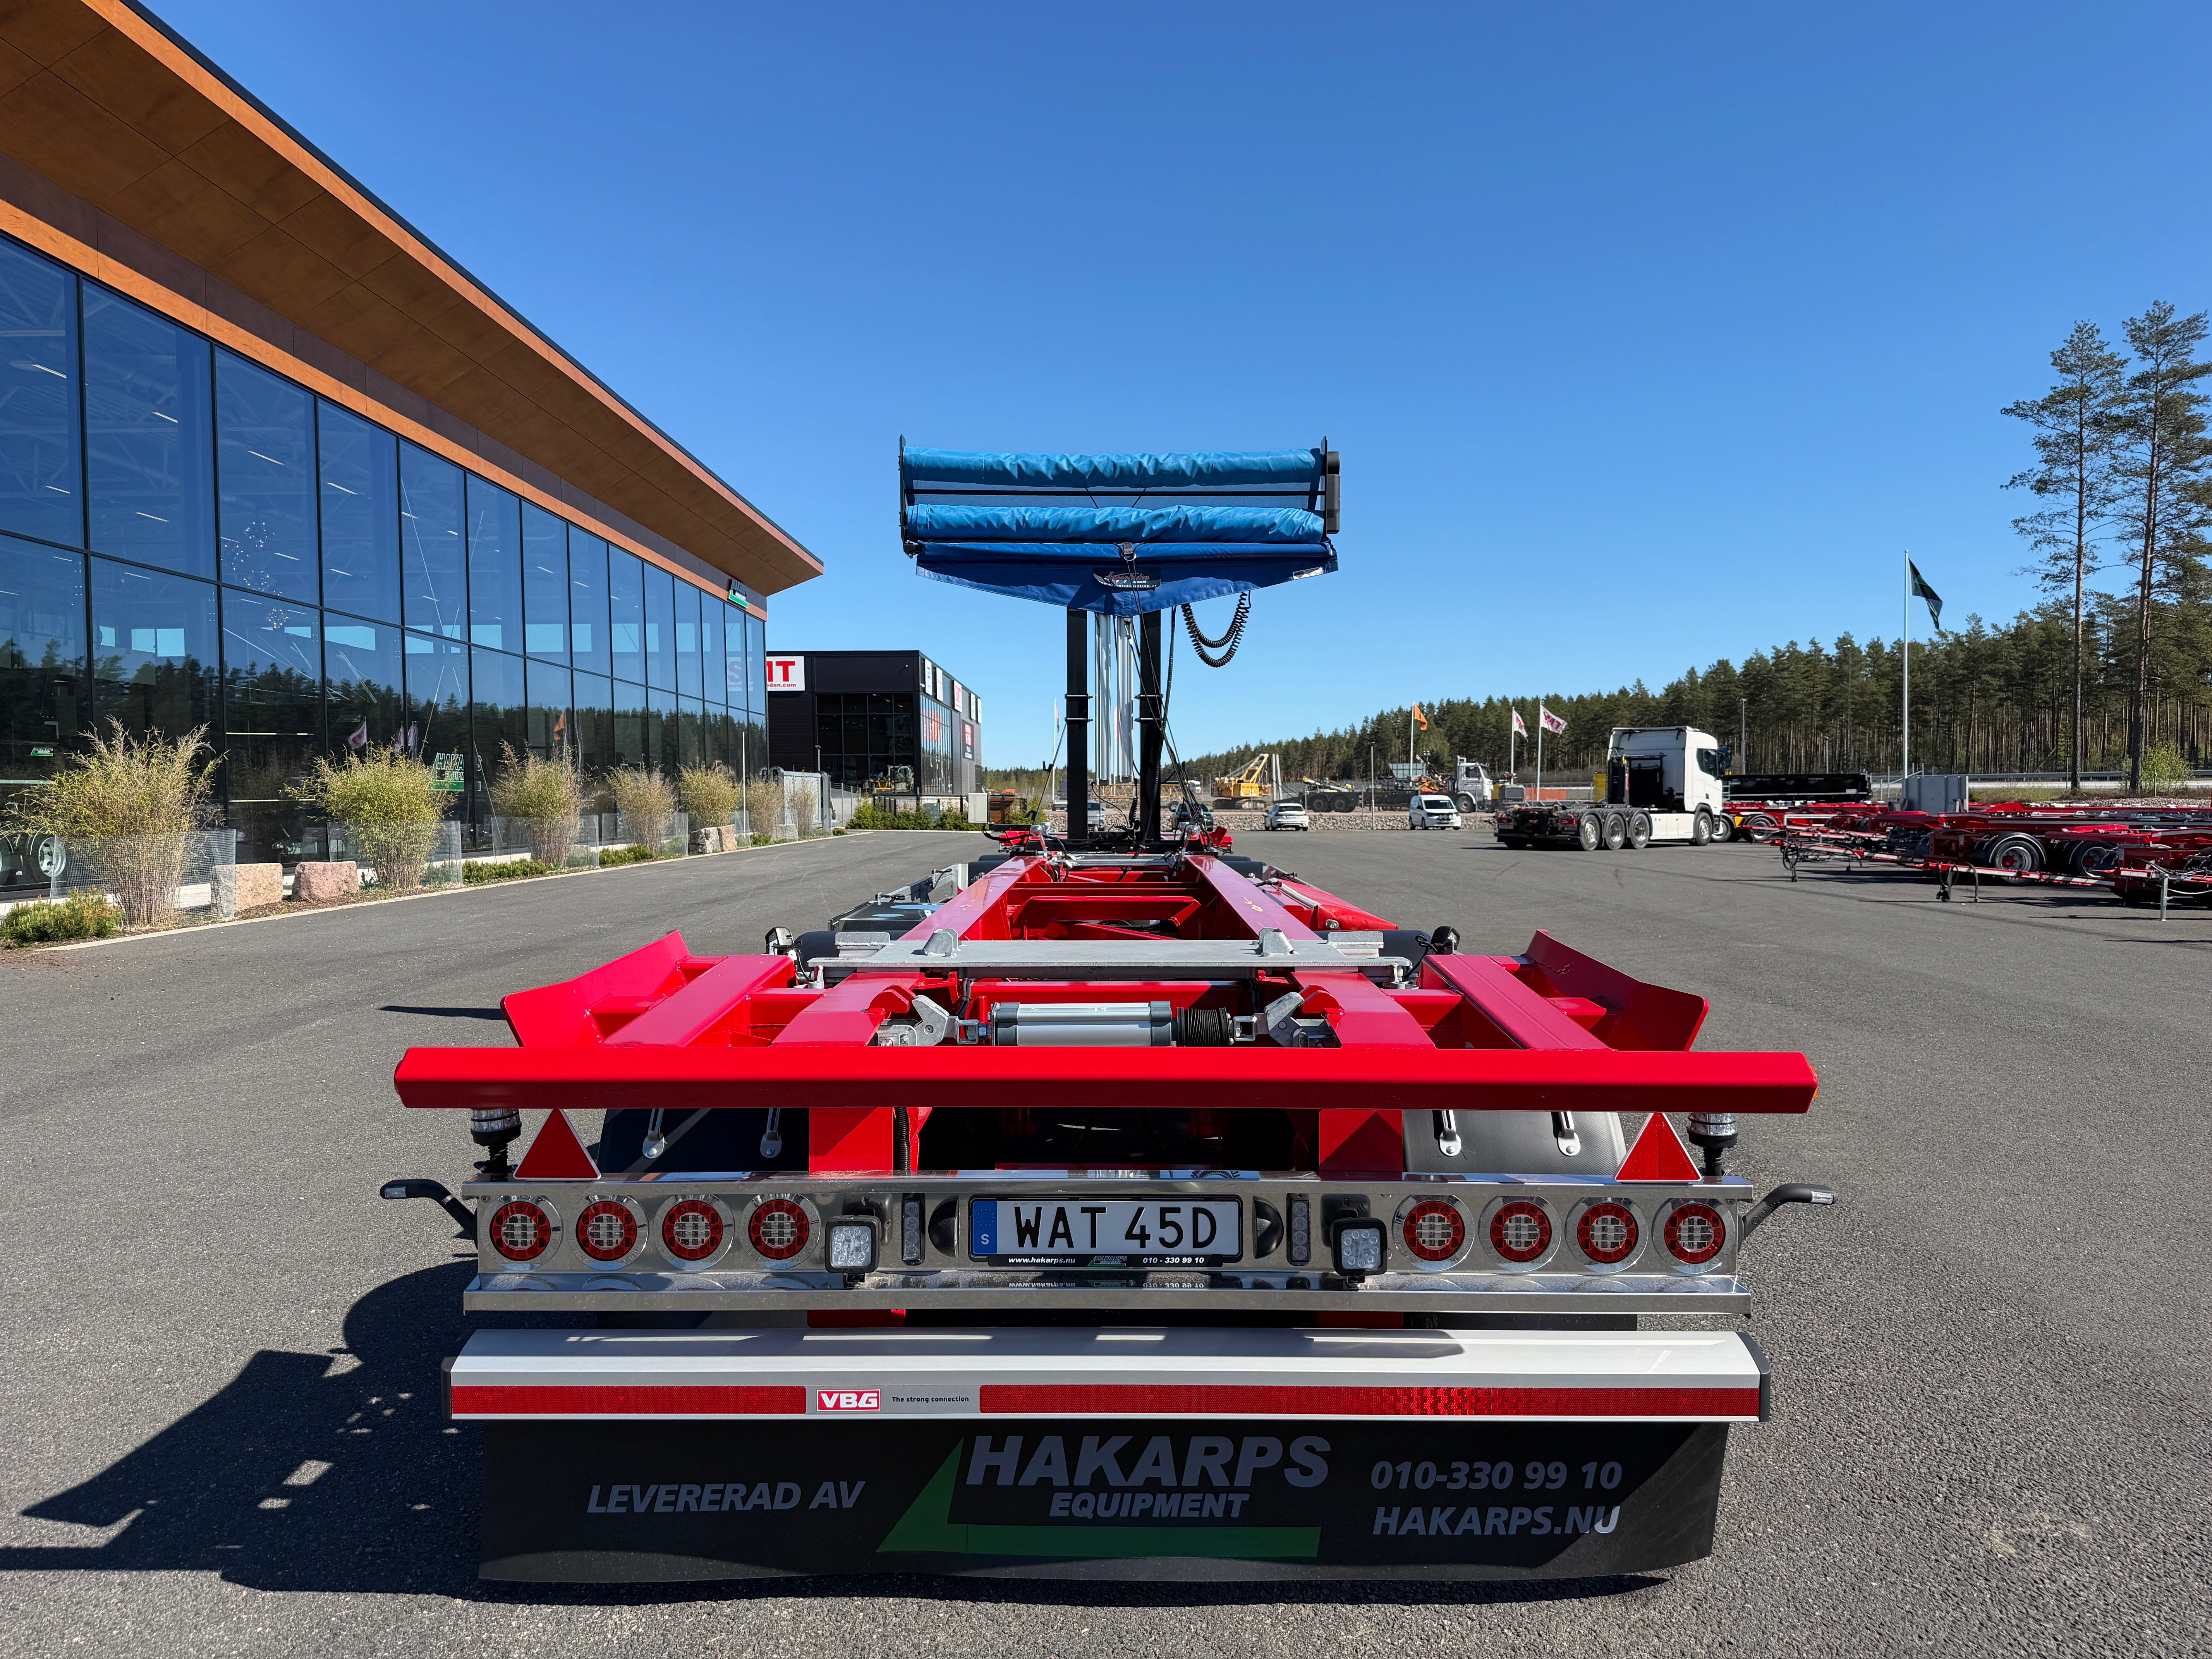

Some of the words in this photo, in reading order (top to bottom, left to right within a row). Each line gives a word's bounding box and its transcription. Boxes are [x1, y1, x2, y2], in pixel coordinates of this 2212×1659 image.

[981, 1234, 989, 1245] S
[1014, 1206, 1106, 1248] WAT
[1125, 1207, 1217, 1249] 45D
[820, 1393, 878, 1408] VBG
[965, 1435, 1331, 1488] HAKARPS
[1371, 1461, 1514, 1490] 010-330
[1523, 1461, 1567, 1490] 99
[1582, 1461, 1622, 1490] 10
[587, 1482, 801, 1513] LEVERERAD
[809, 1481, 866, 1509] AV
[1049, 1492, 1250, 1520] EQUIPMENT
[1372, 1505, 1621, 1535] HAKARPS.NU
